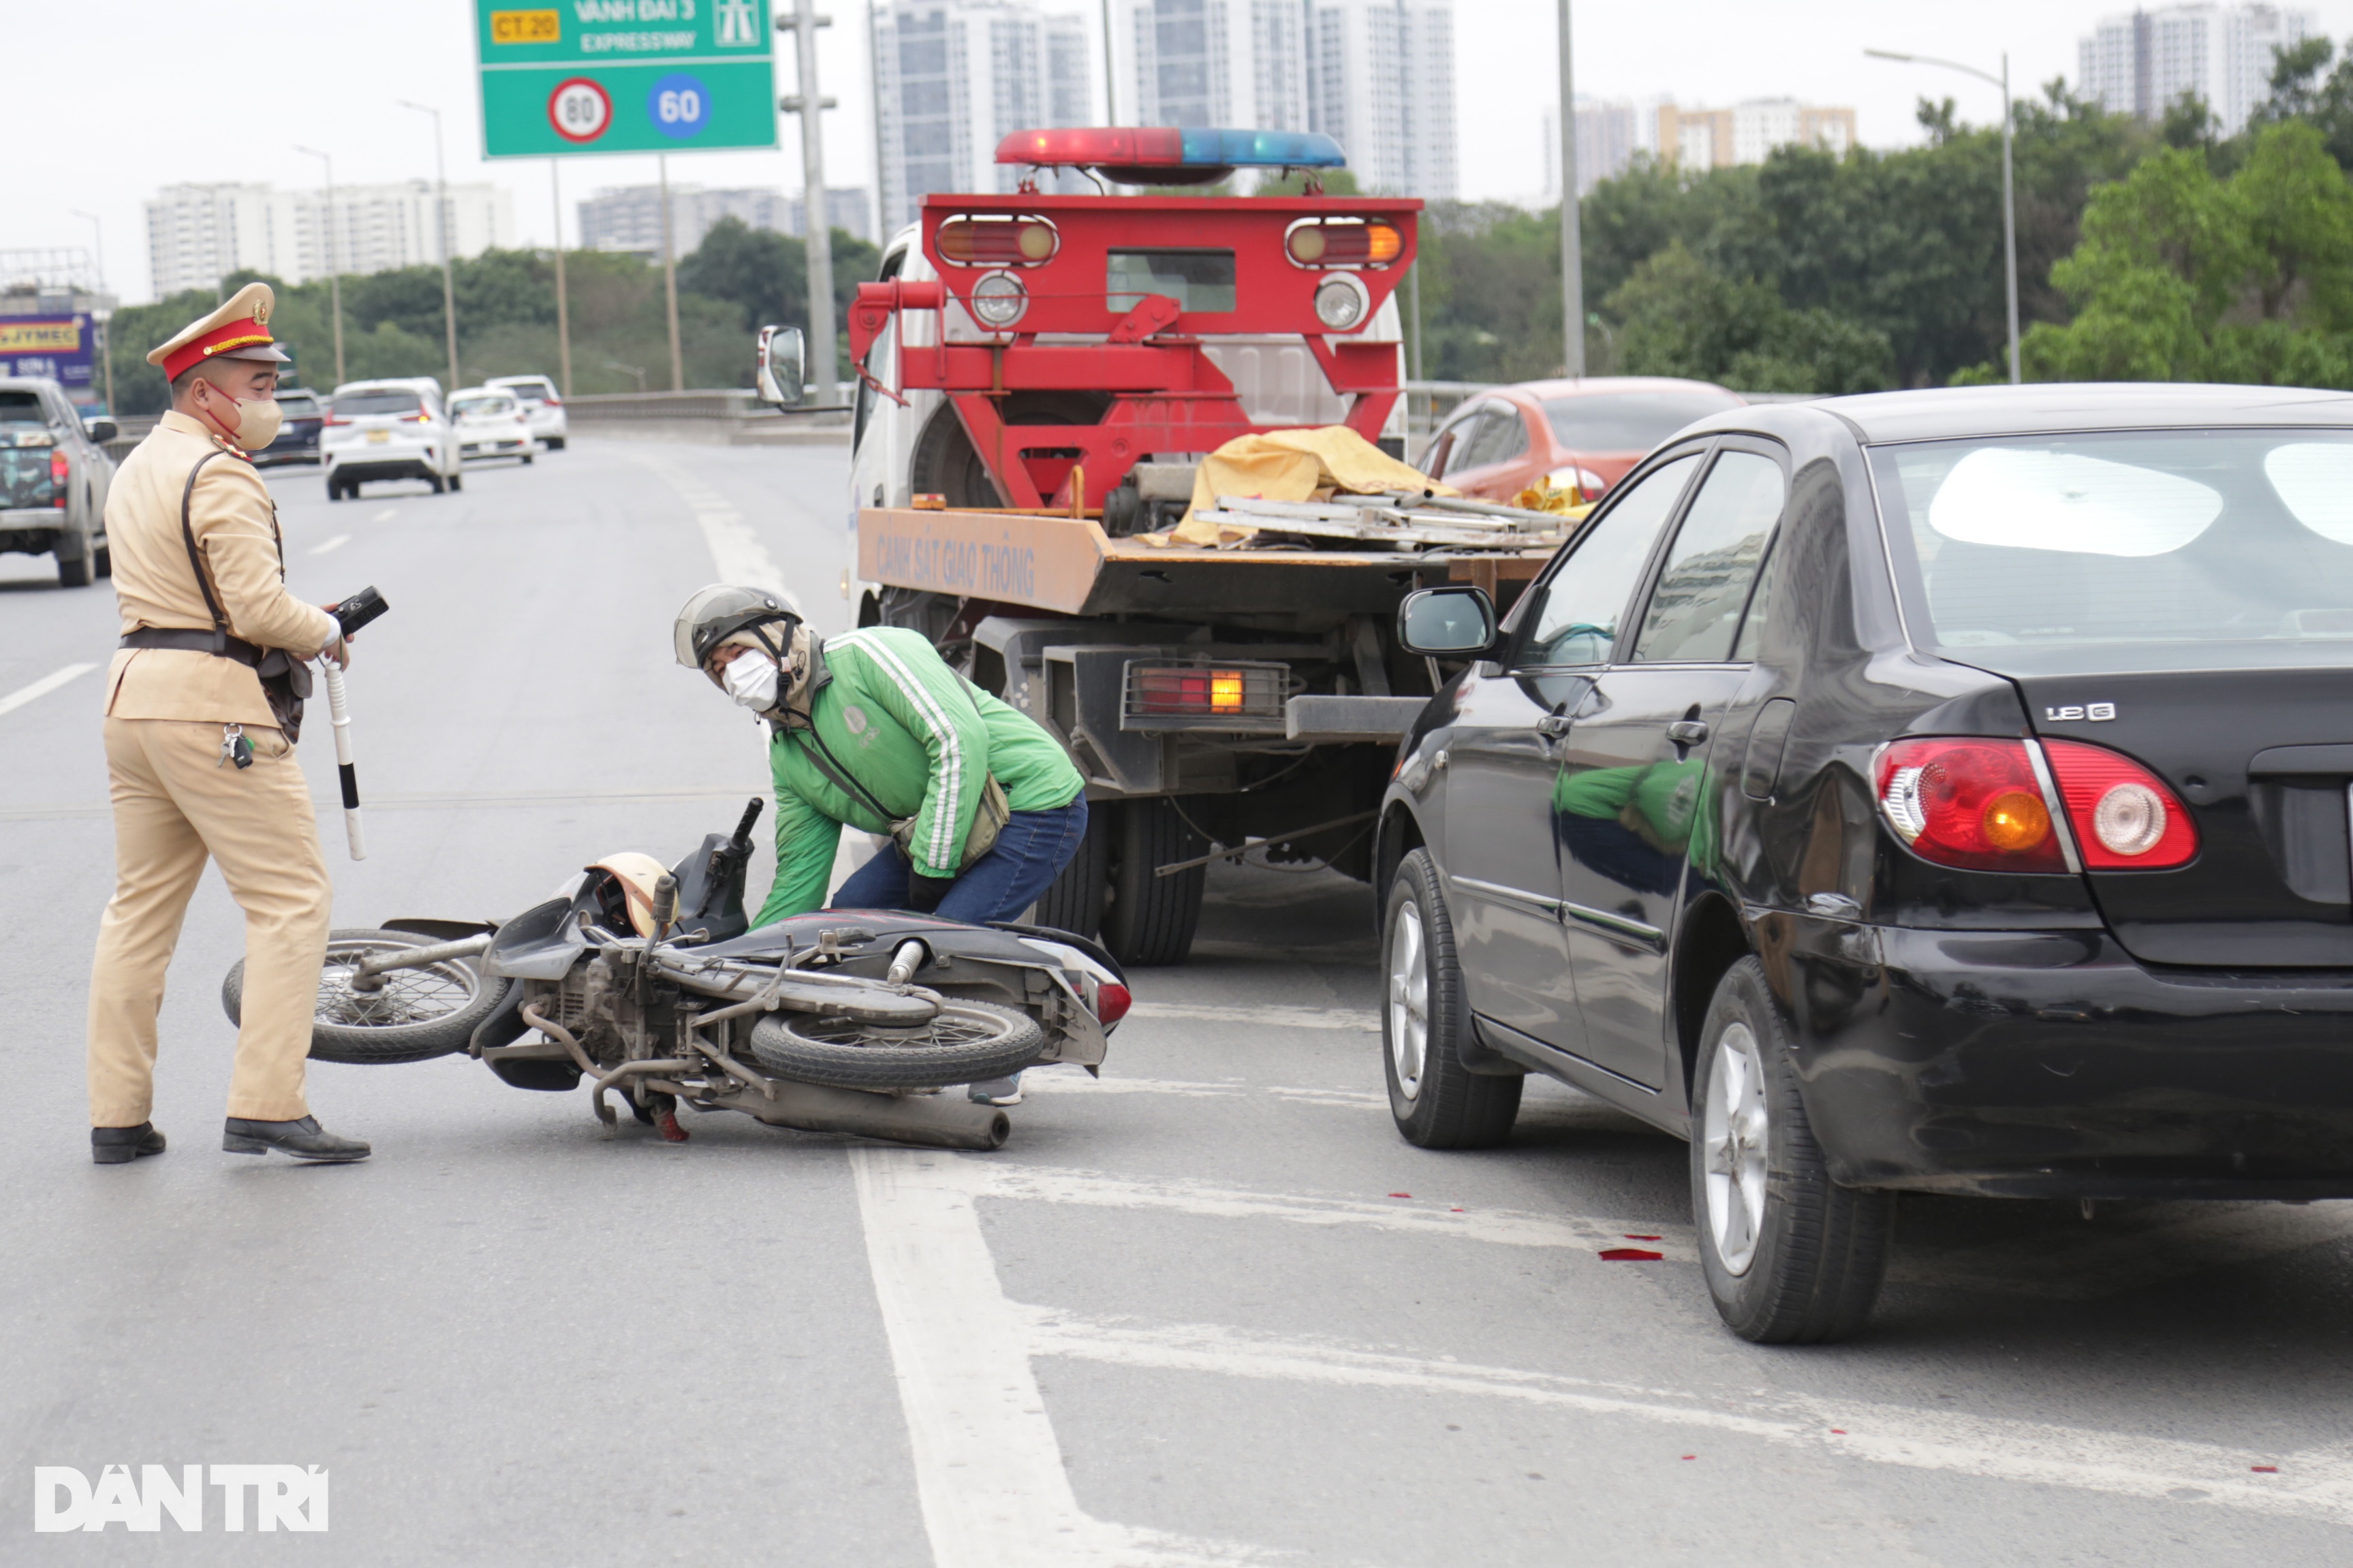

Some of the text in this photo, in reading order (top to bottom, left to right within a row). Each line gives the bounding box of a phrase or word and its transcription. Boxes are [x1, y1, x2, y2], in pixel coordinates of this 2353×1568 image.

[680, 0, 696, 20] 3
[580, 31, 696, 52] EXPRESSWAY
[565, 95, 595, 124] 80
[659, 89, 700, 123] 60
[915, 524, 939, 584] SÁT
[943, 540, 977, 589] GIAO
[982, 530, 1034, 598] THÔNG
